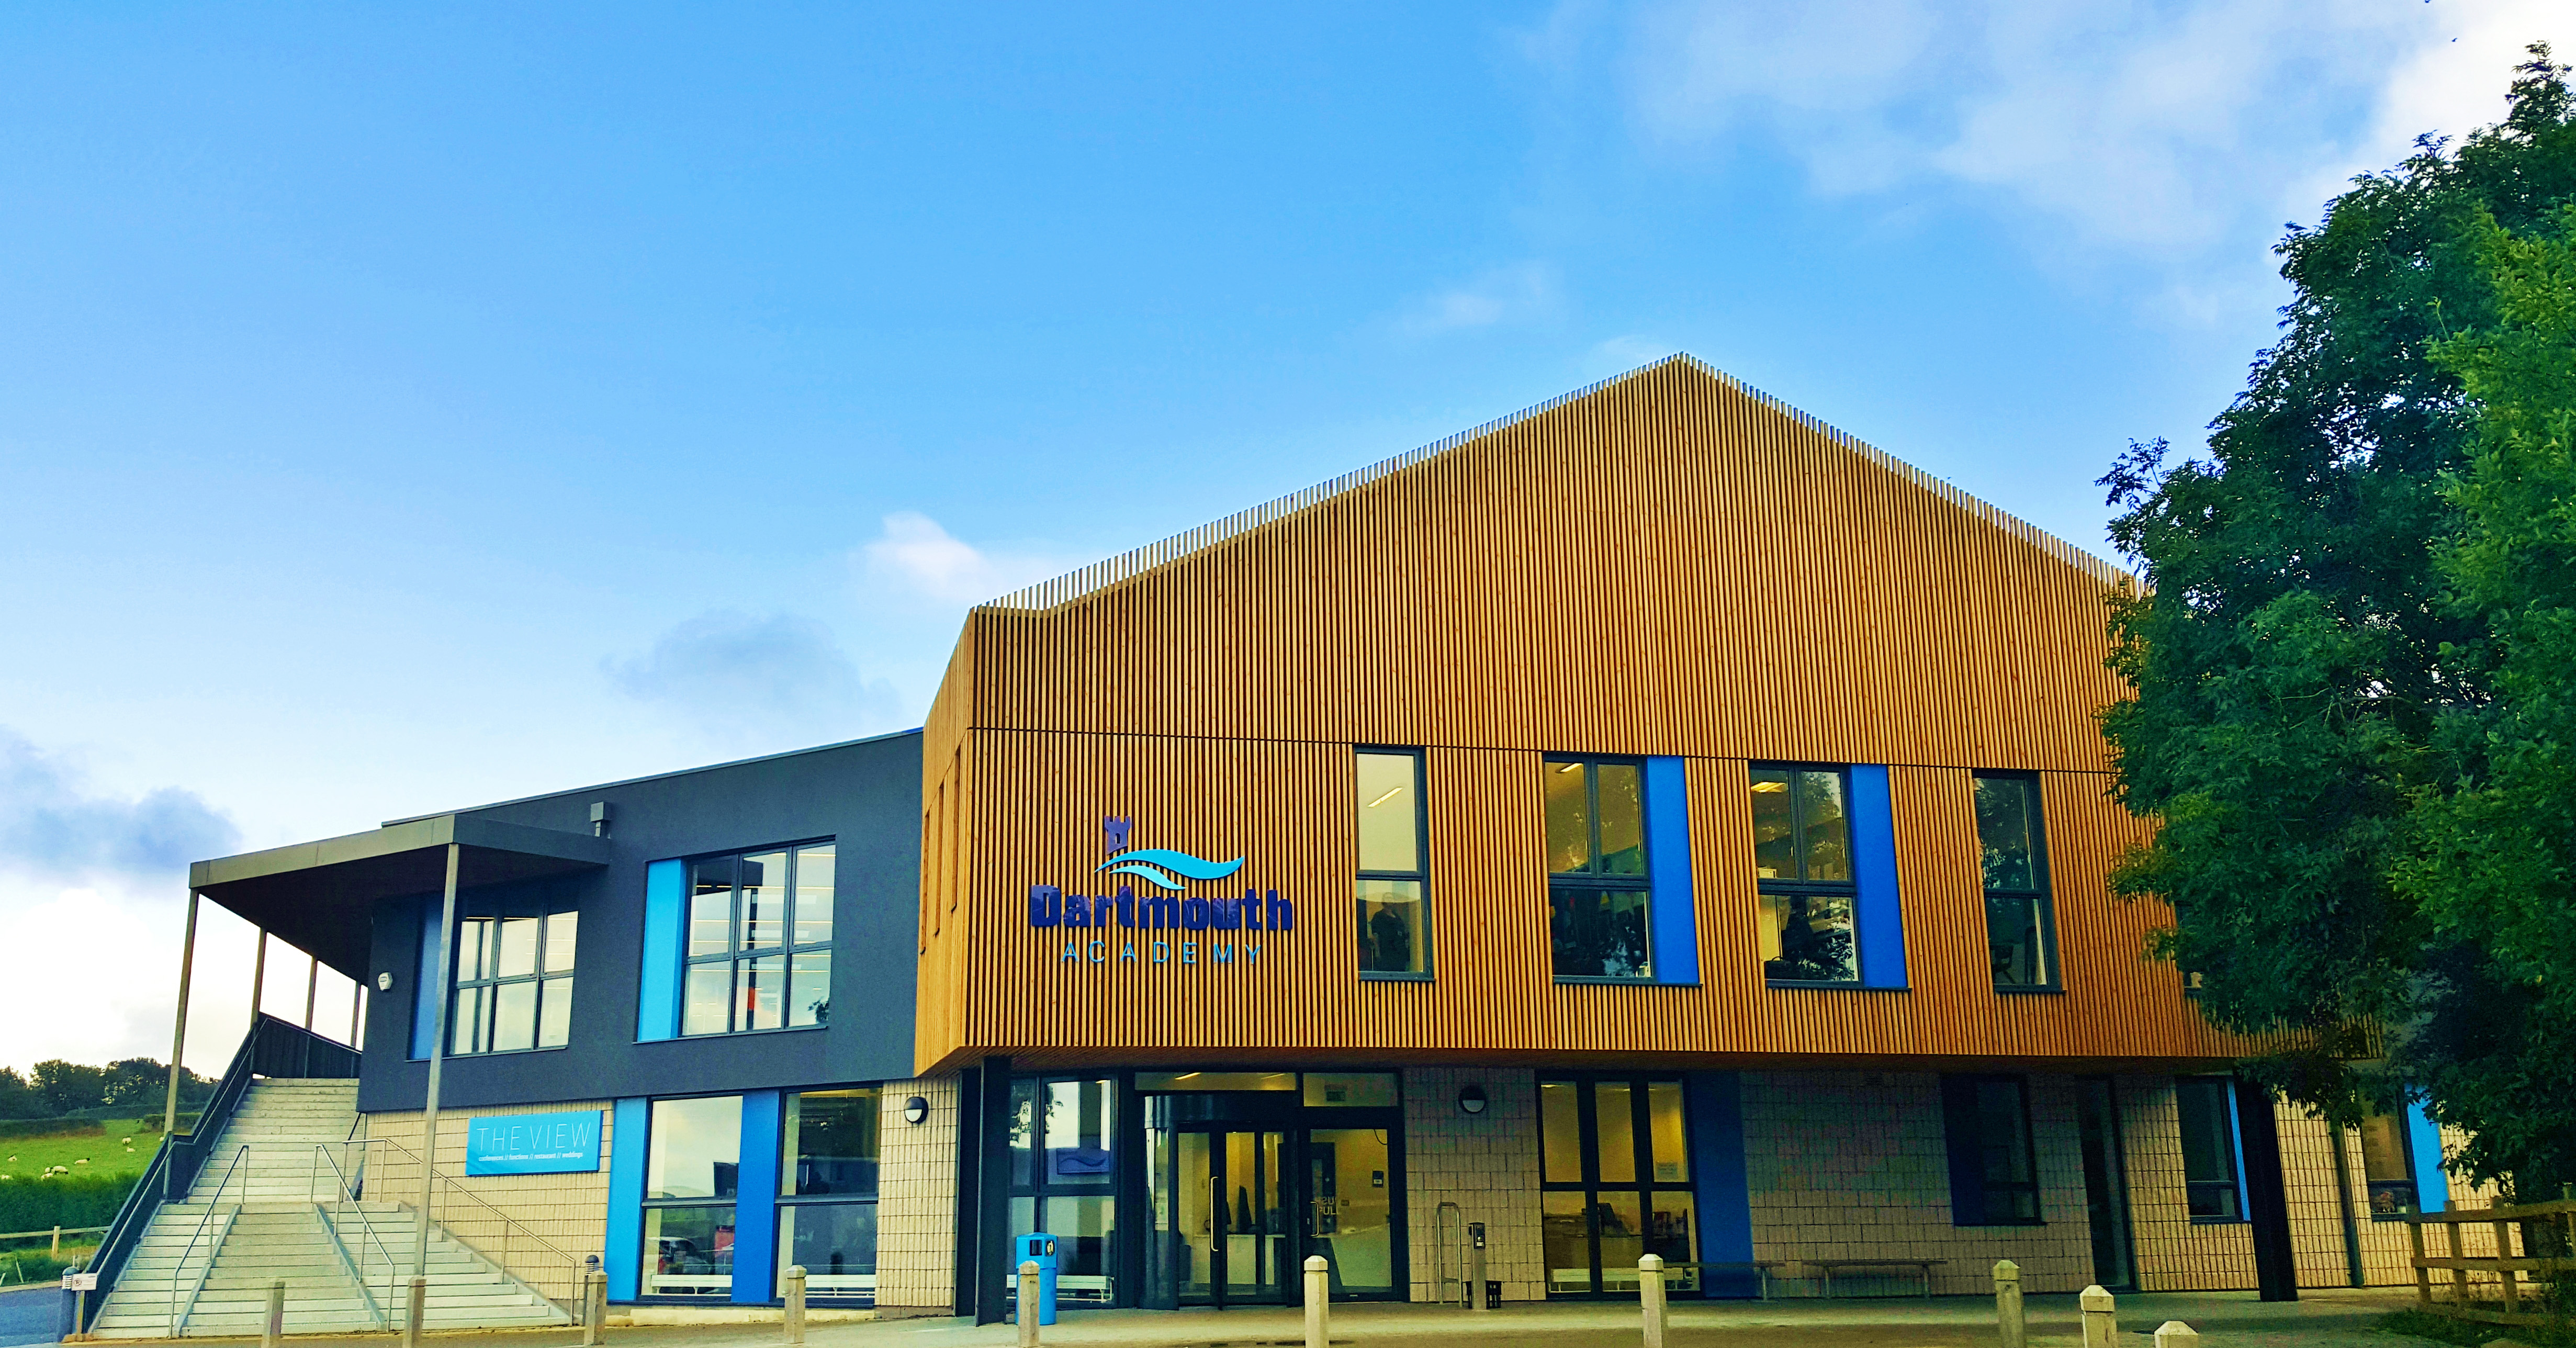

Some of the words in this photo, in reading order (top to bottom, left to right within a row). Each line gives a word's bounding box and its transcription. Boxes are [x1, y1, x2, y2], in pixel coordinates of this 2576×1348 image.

[1031, 885, 1292, 930] Dartmouth
[1062, 941, 1261, 964] ACADEMY
[477, 1126, 522, 1151] THE
[530, 1122, 590, 1149] VIEW
